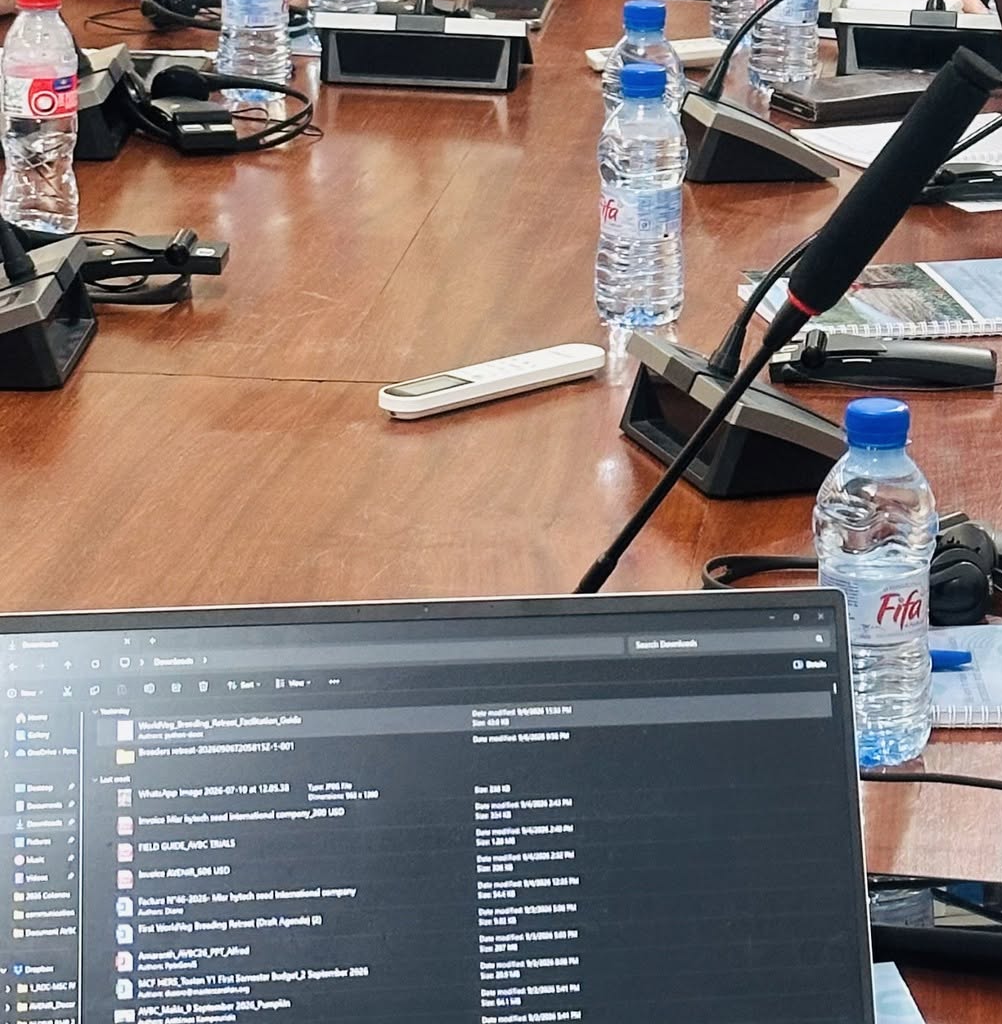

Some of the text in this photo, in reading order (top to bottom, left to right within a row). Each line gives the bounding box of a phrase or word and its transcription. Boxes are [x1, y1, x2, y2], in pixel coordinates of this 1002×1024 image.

[877, 589, 922, 631] Fifa
[138, 788, 178, 799] WhatsApp
[138, 842, 159, 852] FIELD
